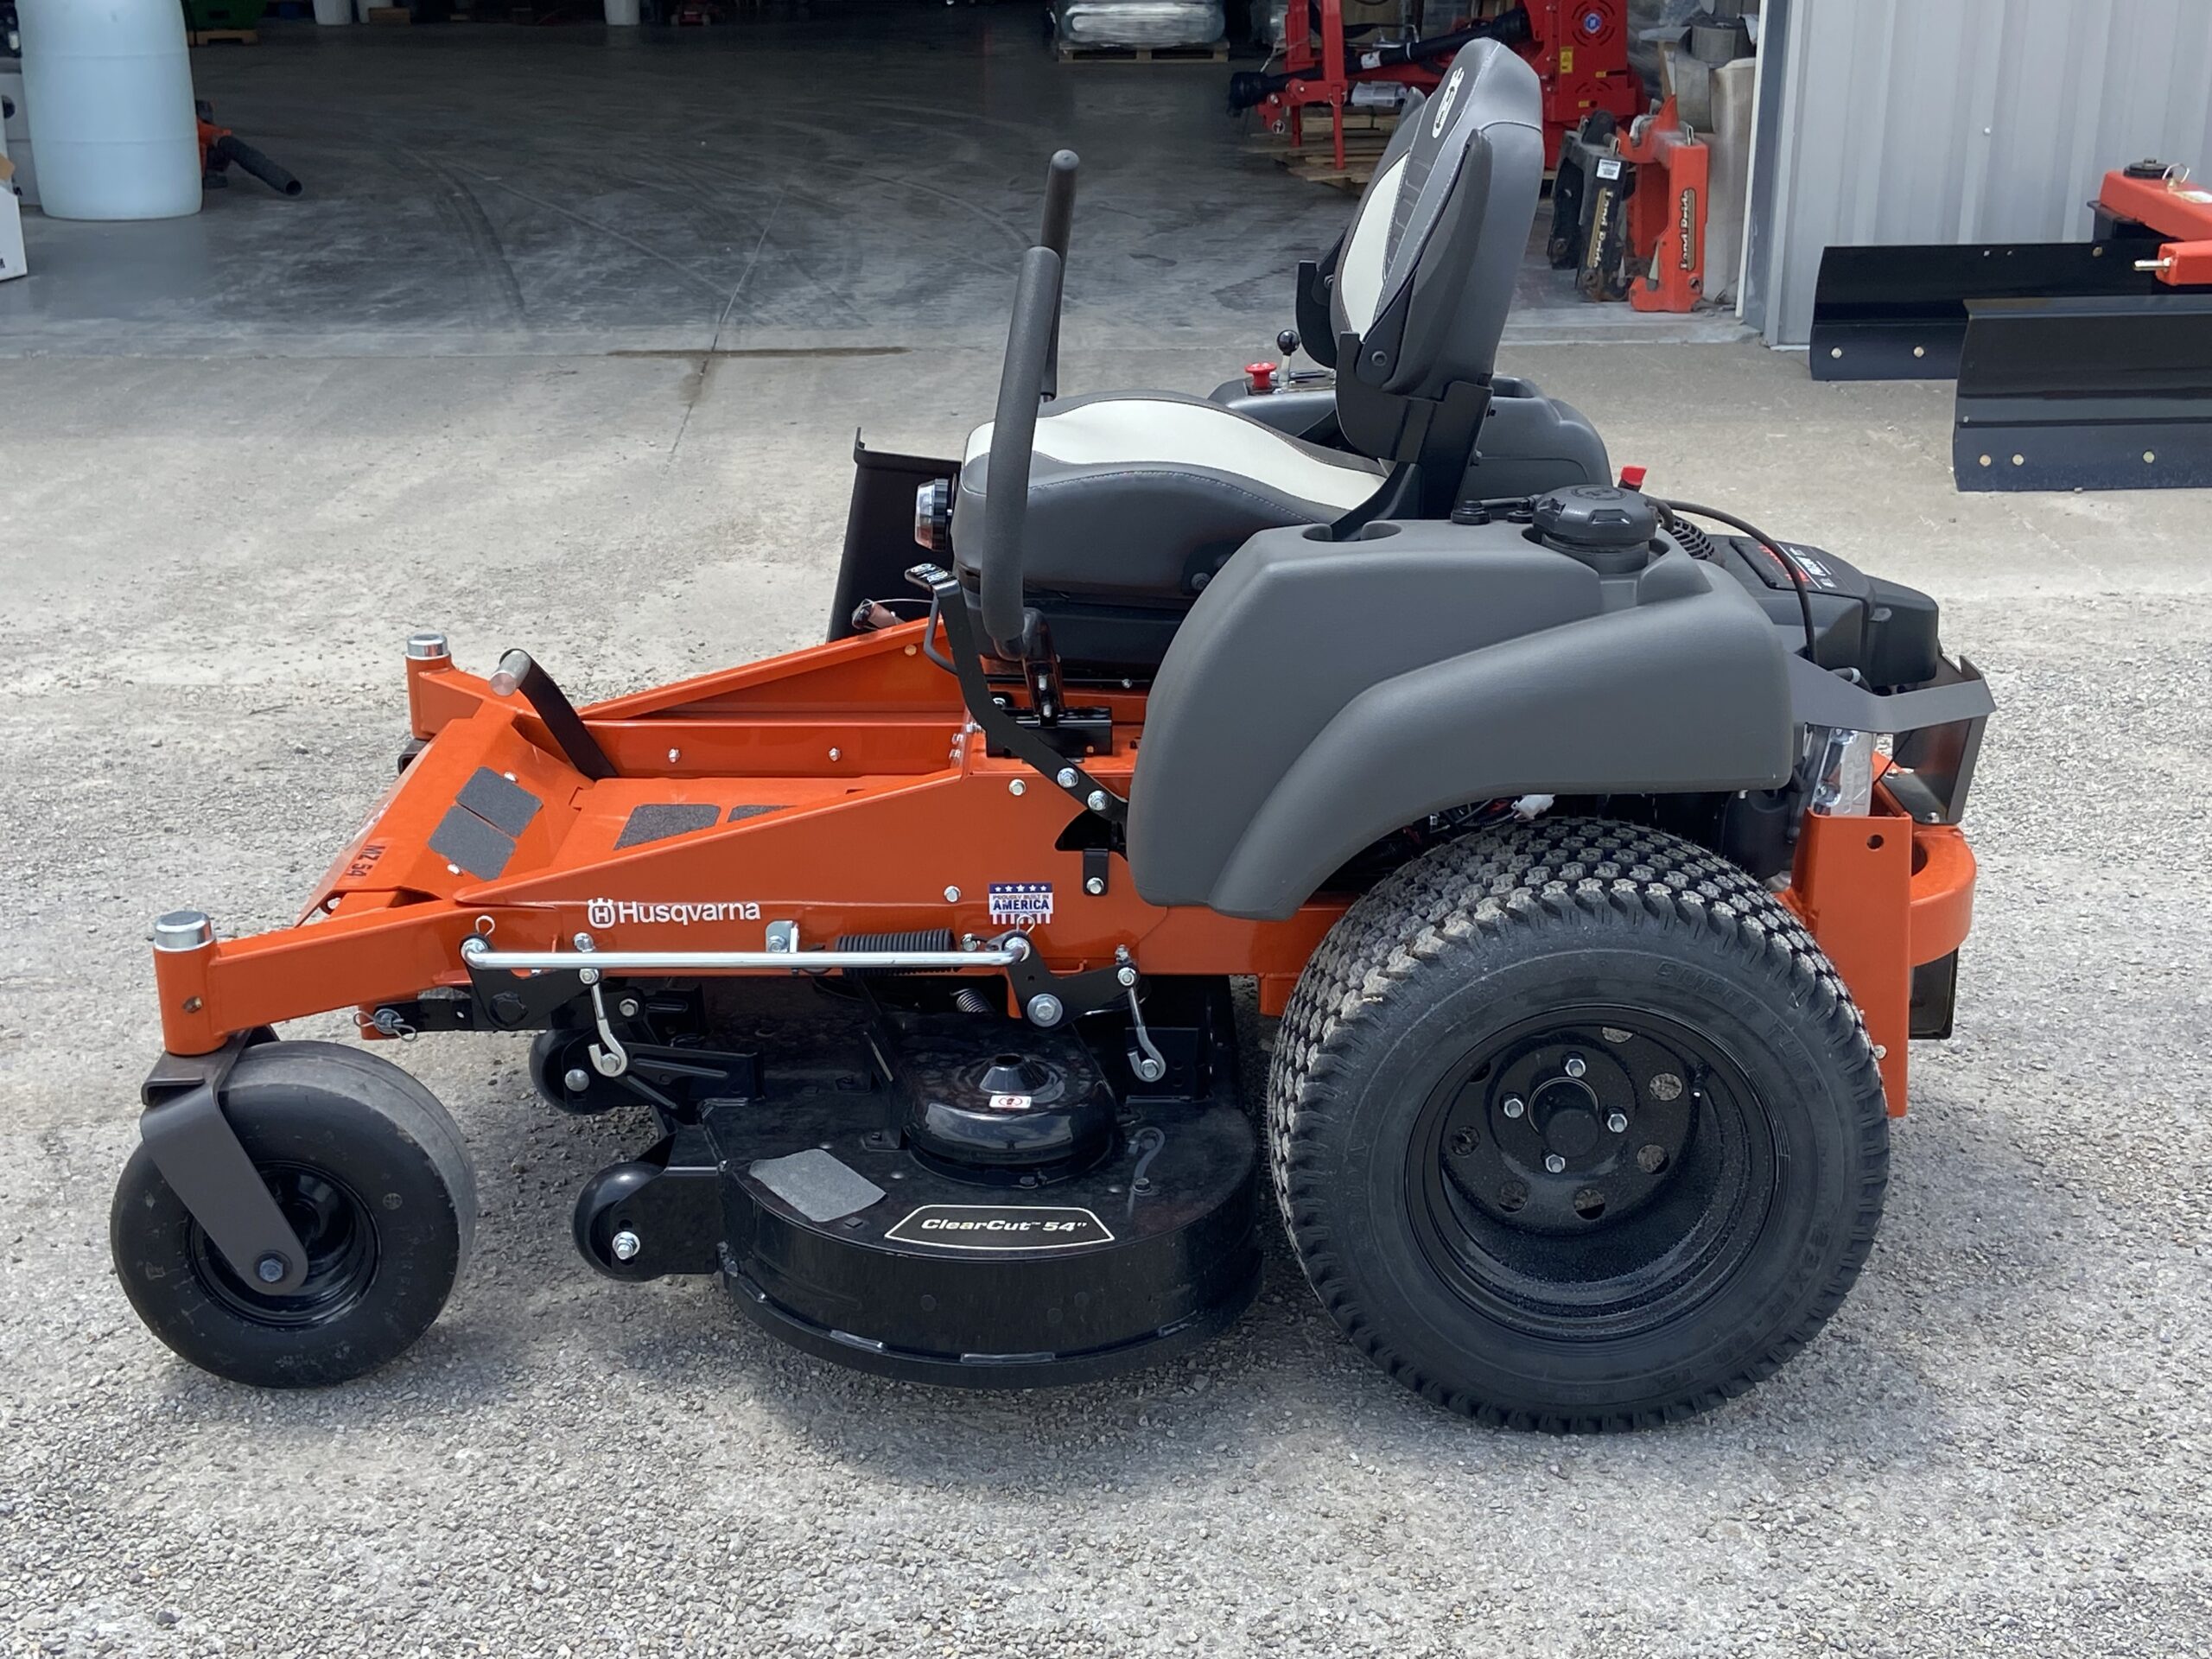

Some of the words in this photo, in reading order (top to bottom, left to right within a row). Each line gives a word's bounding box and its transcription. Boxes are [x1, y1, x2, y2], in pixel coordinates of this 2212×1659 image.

[357, 845, 386, 861] MZ
[346, 863, 373, 877] 54
[993, 899, 1050, 910] AMERICA
[618, 901, 761, 926] Husqvarna
